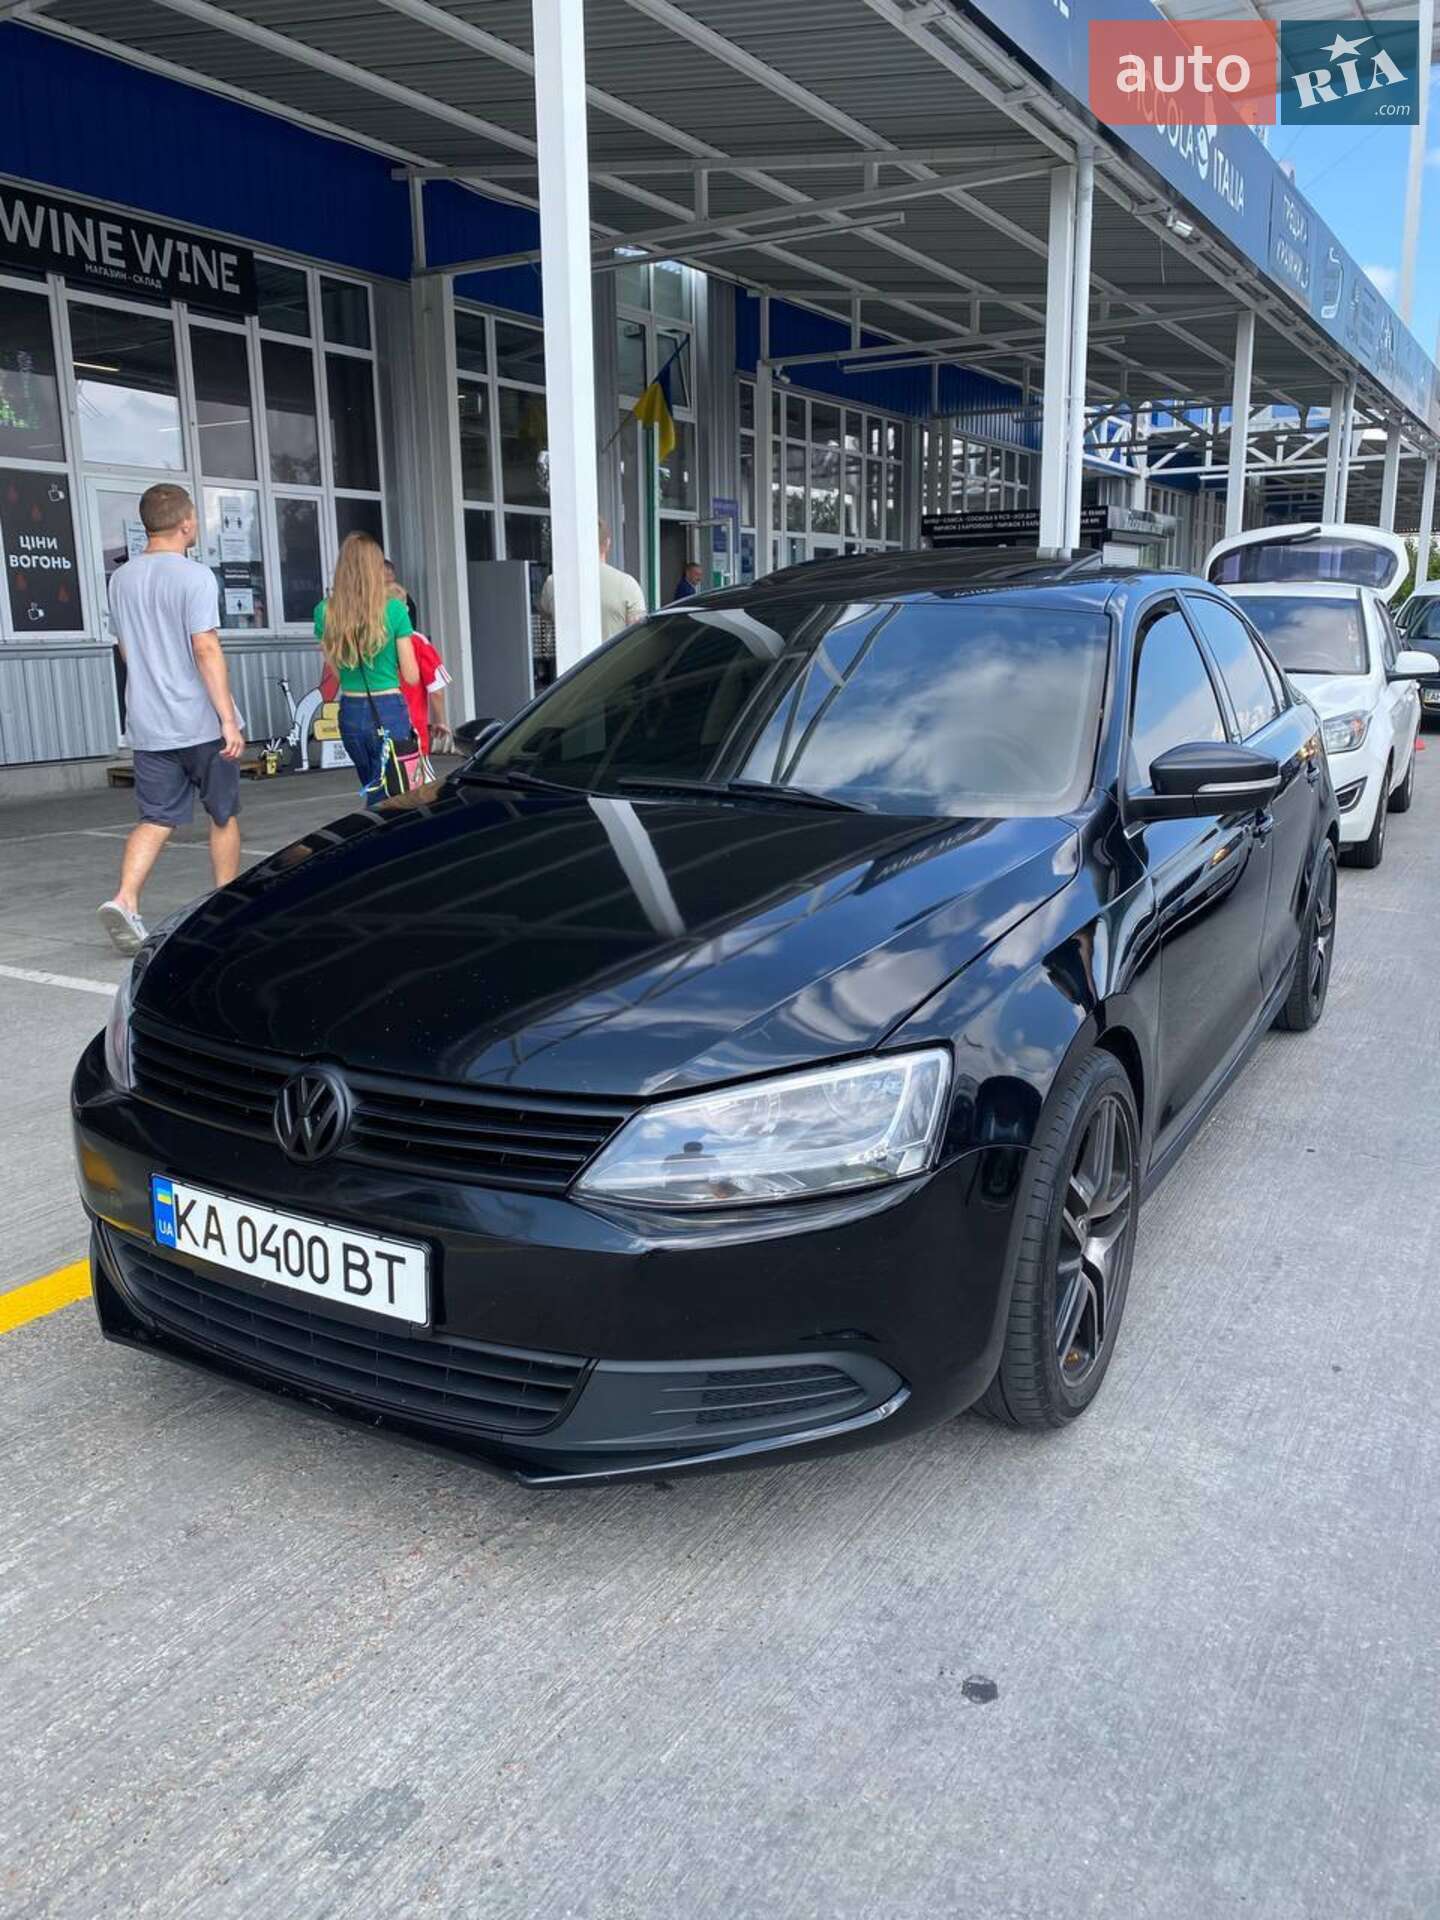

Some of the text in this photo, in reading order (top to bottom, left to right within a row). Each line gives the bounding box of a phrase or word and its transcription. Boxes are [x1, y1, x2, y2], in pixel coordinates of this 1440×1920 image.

[1213, 147, 1245, 216] ITALIA
[0, 196, 241, 295] WINE WINE
[9, 553, 72, 570] ВОГОНЬ
[19, 534, 58, 550] ЦІНИ
[159, 1220, 174, 1236] UA
[174, 1194, 406, 1304] KA 0400 BT
